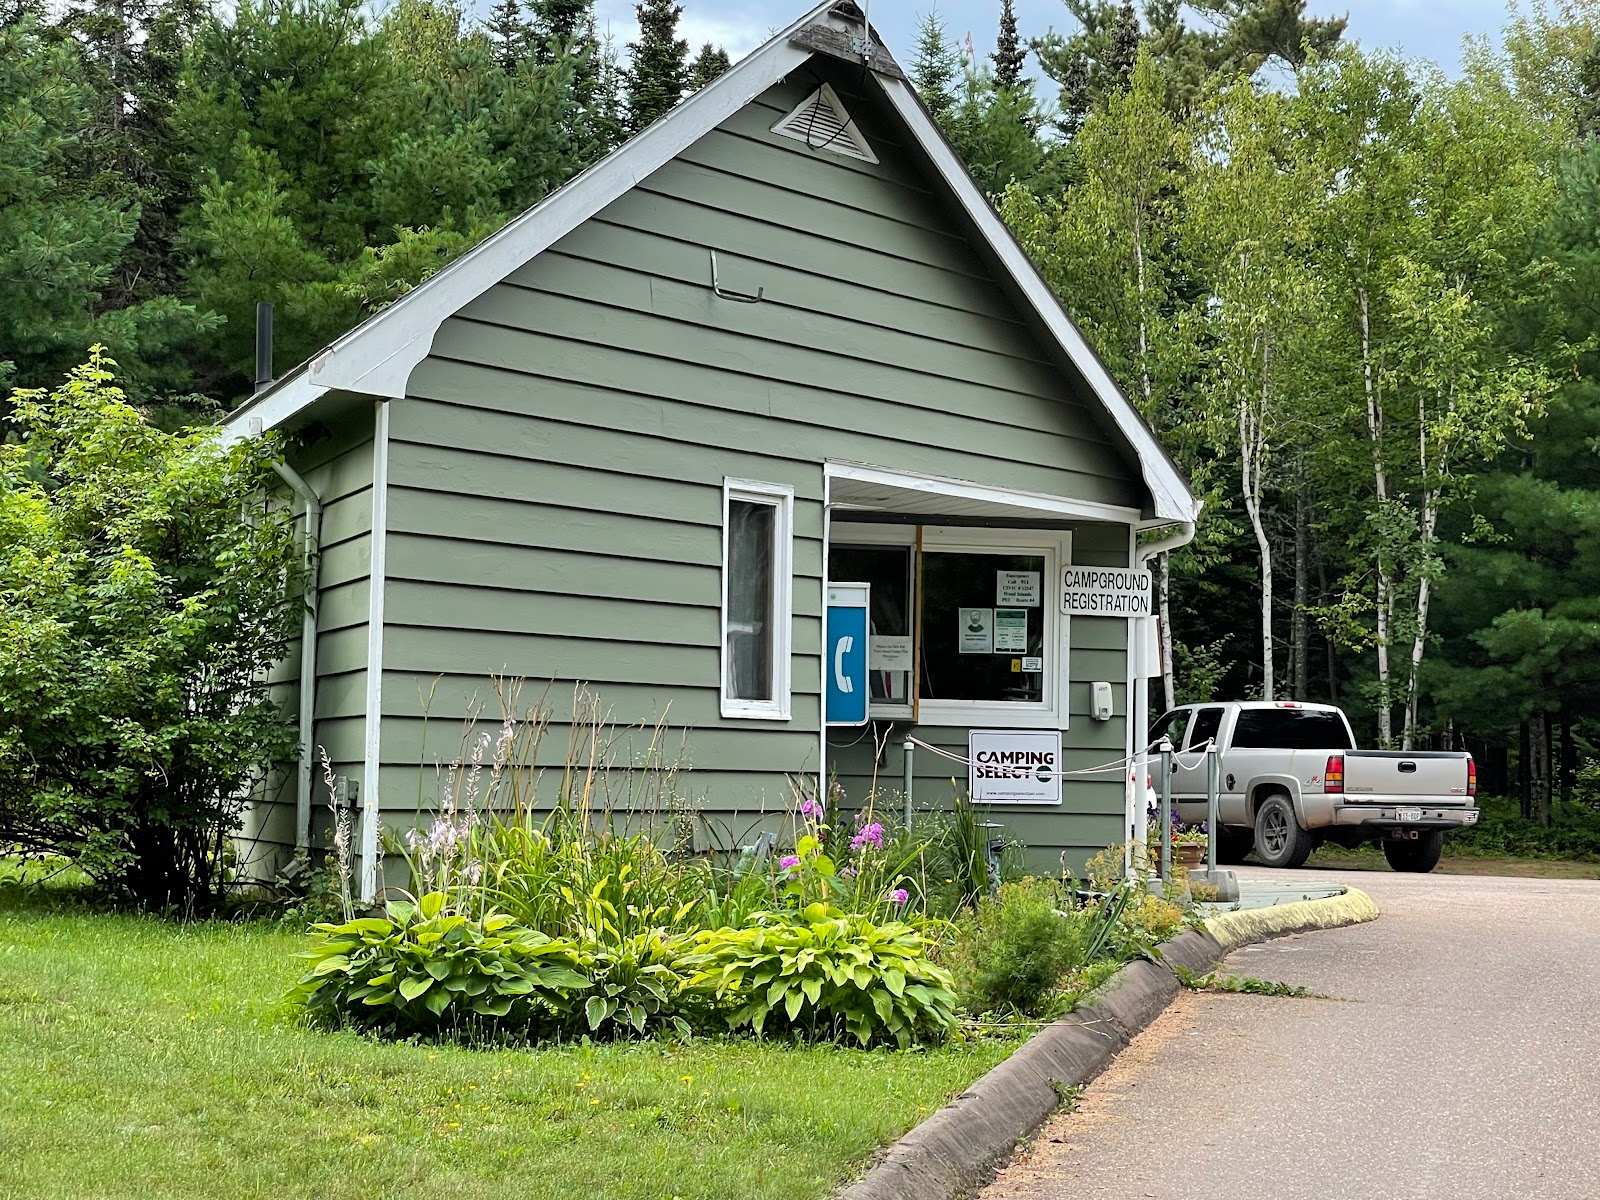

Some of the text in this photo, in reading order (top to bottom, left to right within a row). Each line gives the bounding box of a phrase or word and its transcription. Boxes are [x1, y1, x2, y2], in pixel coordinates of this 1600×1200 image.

[1064, 570, 1149, 591] CAMPGROUND
[1063, 592, 1148, 613] REGISTRATION
[977, 751, 1054, 764] CAMPING
[976, 765, 1033, 779] SELECT
